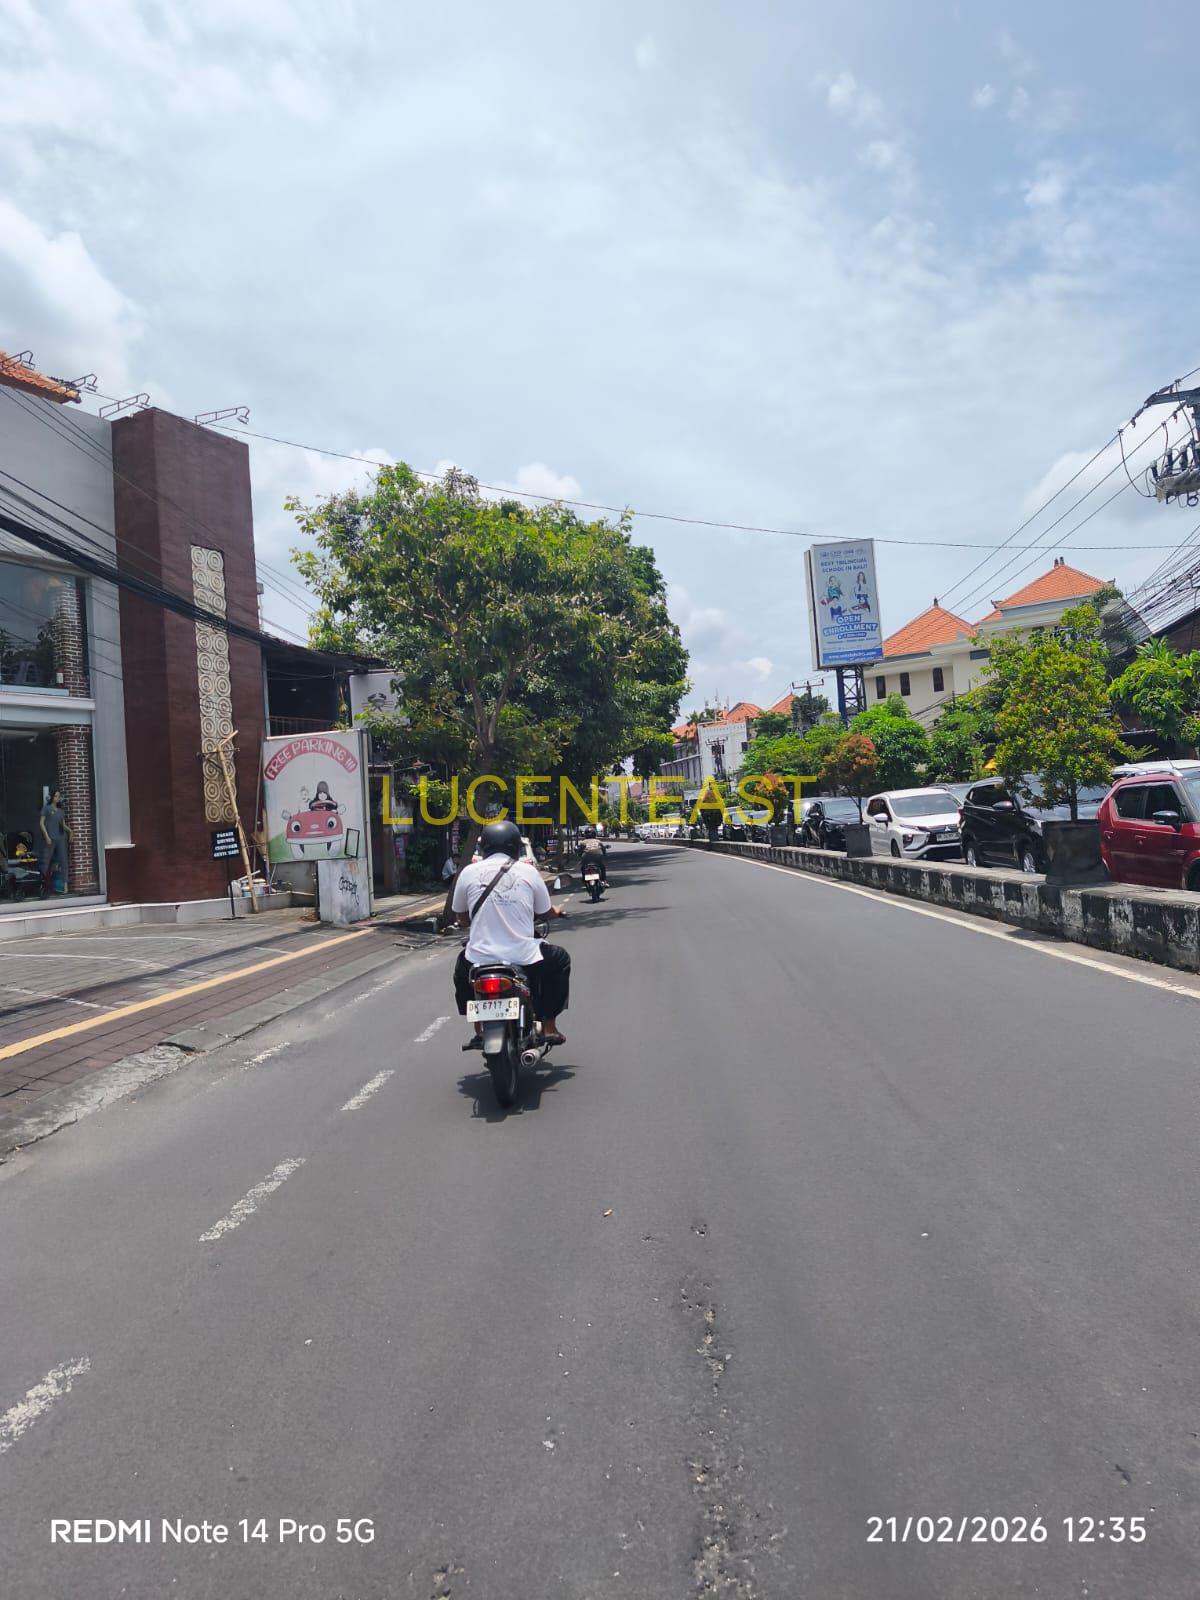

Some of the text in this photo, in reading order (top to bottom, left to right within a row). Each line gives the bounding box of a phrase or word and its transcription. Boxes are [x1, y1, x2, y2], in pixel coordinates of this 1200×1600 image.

[837, 614, 861, 624] OPEN
[823, 623, 878, 636] ENROLLMENT
[266, 747, 292, 779] FREE
[291, 738, 347, 761] PARKING
[469, 1000, 518, 1013] DK 6717 CR
